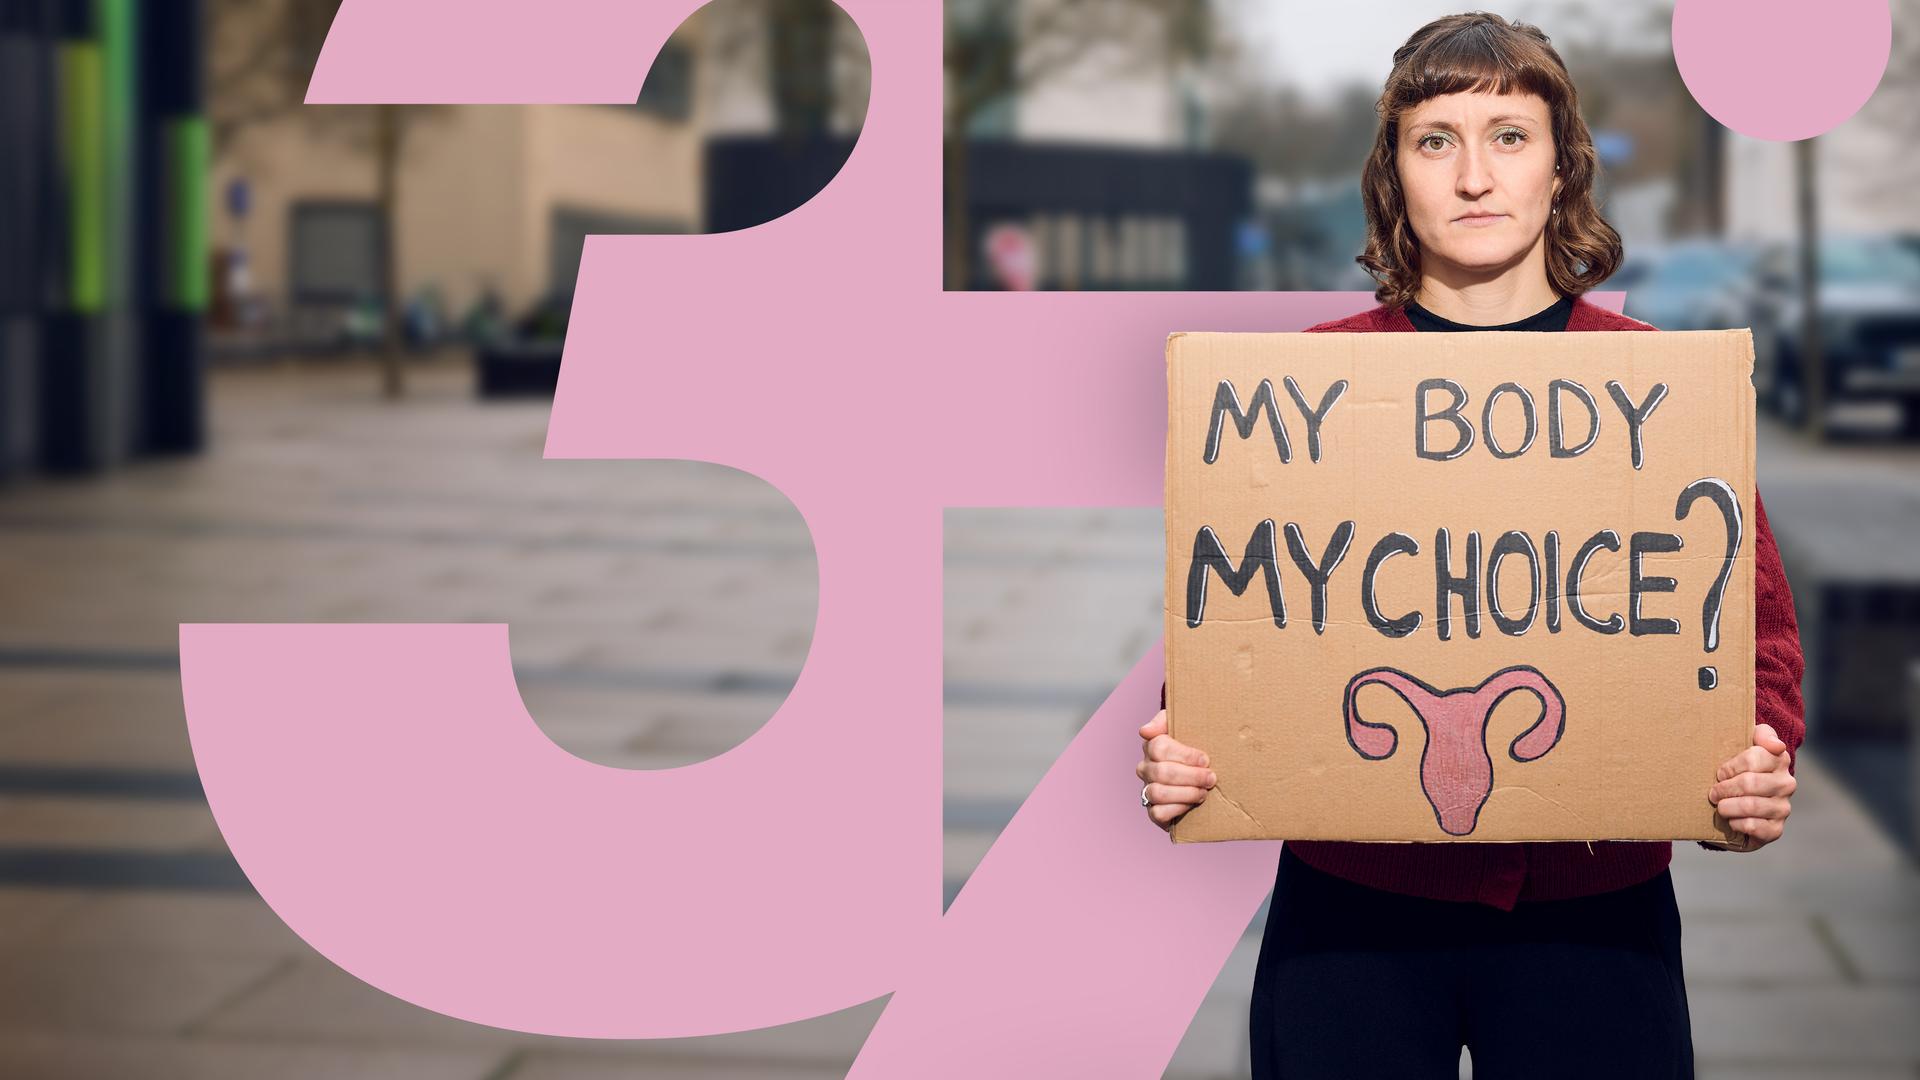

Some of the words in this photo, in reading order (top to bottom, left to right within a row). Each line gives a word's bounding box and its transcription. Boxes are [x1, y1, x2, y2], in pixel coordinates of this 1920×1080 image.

[1203, 376, 1348, 464] MY
[1416, 378, 1668, 470] BODY
[1186, 519, 1356, 634] MY
[1362, 477, 1743, 690] CHOICE?
